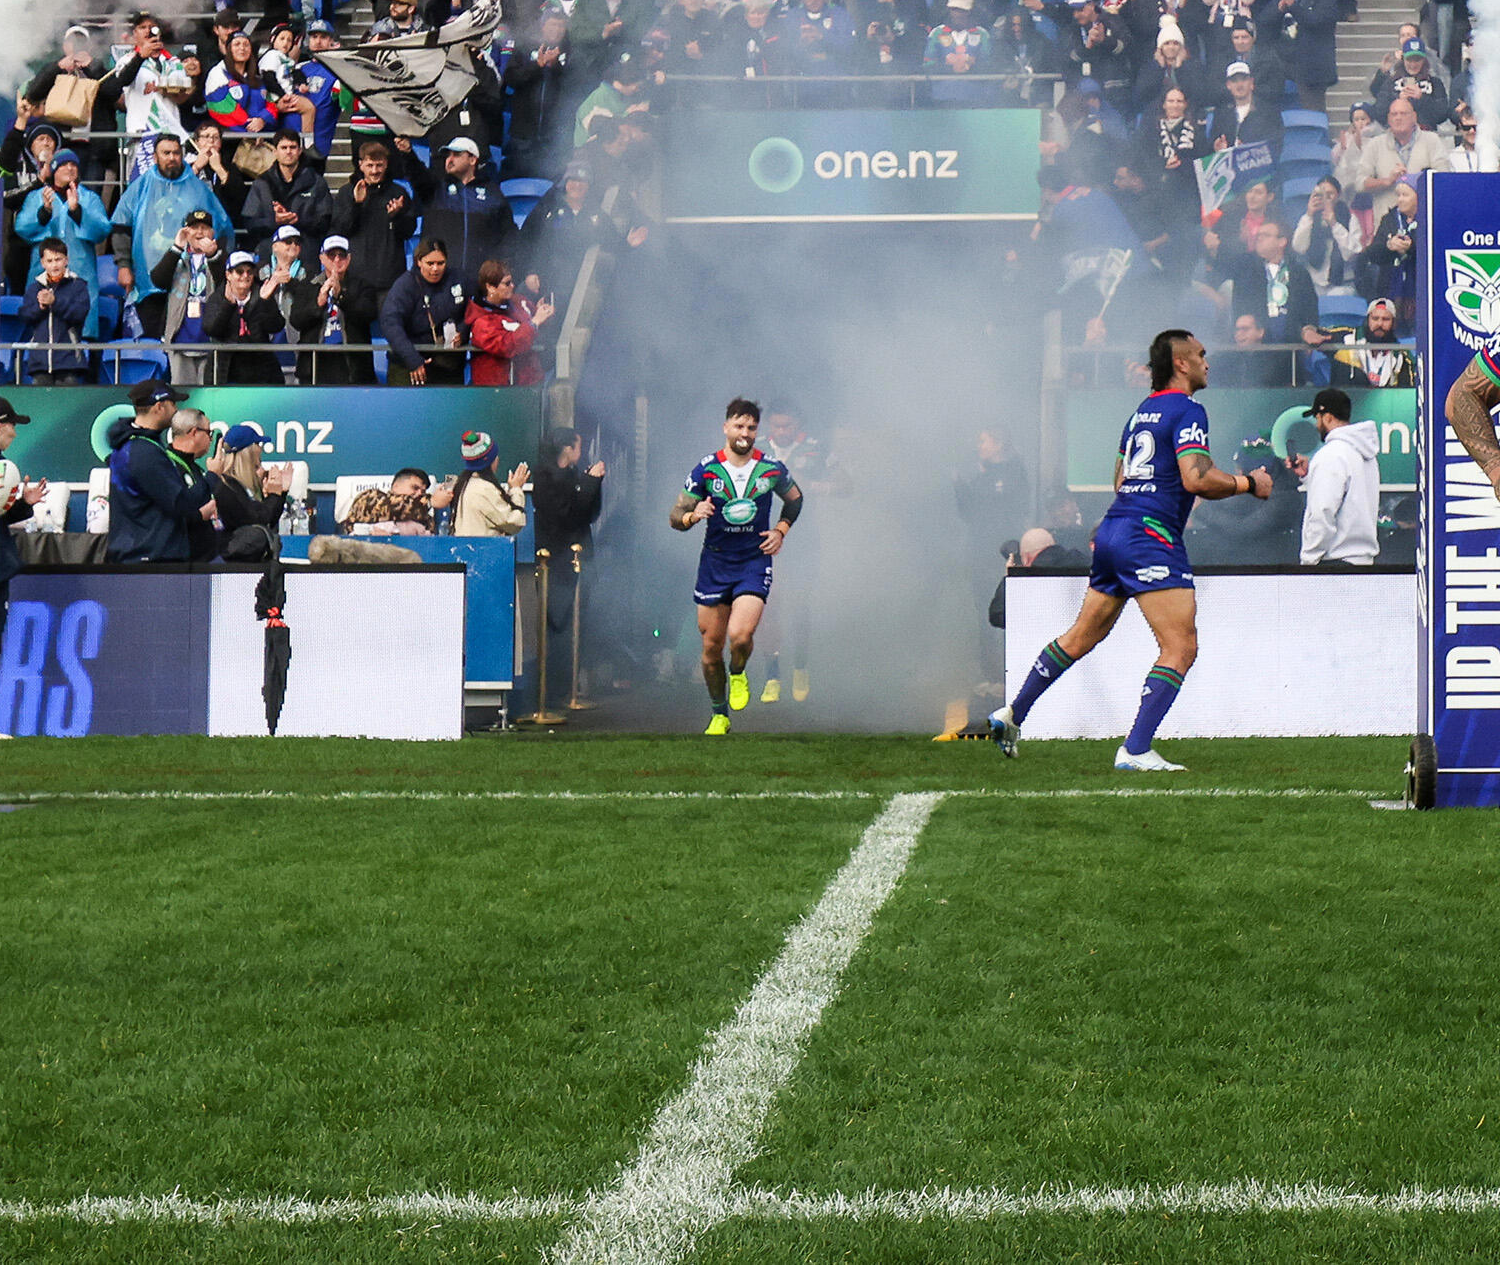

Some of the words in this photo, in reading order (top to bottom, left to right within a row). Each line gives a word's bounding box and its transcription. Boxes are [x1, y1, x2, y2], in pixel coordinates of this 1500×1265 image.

[814, 150, 959, 179] one.nz
[1462, 230, 1494, 246] One
[167, 421, 334, 453] .nz
[1123, 430, 1156, 480] 12
